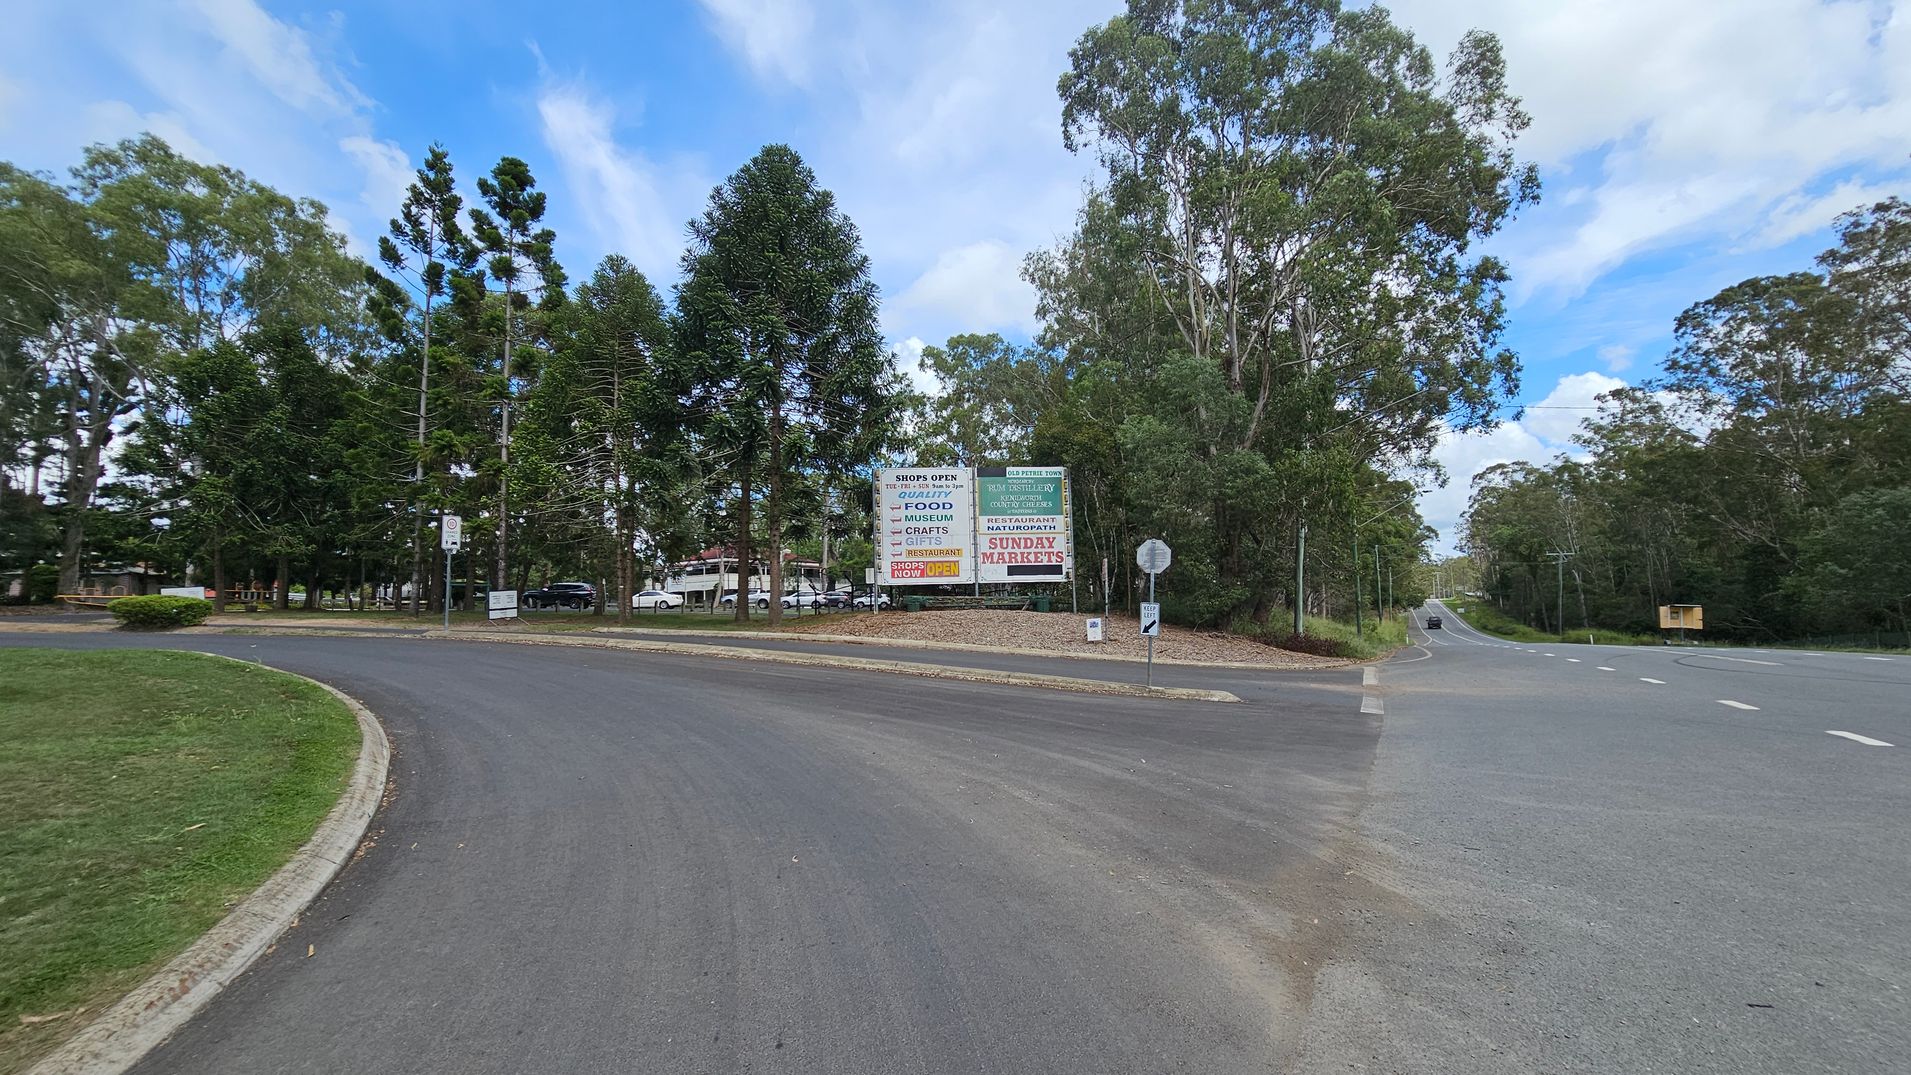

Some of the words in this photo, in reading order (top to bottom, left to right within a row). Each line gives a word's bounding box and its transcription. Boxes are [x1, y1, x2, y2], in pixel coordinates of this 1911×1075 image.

[1009, 484, 1055, 492] DISTILLERY
[898, 491, 952, 499] QUALITY
[904, 502, 953, 510] FOOD
[905, 537, 942, 546] GIFTS
[988, 537, 1056, 550] SUNDAY
[981, 551, 1064, 564] MARKETS
[926, 562, 959, 576] OPEN
